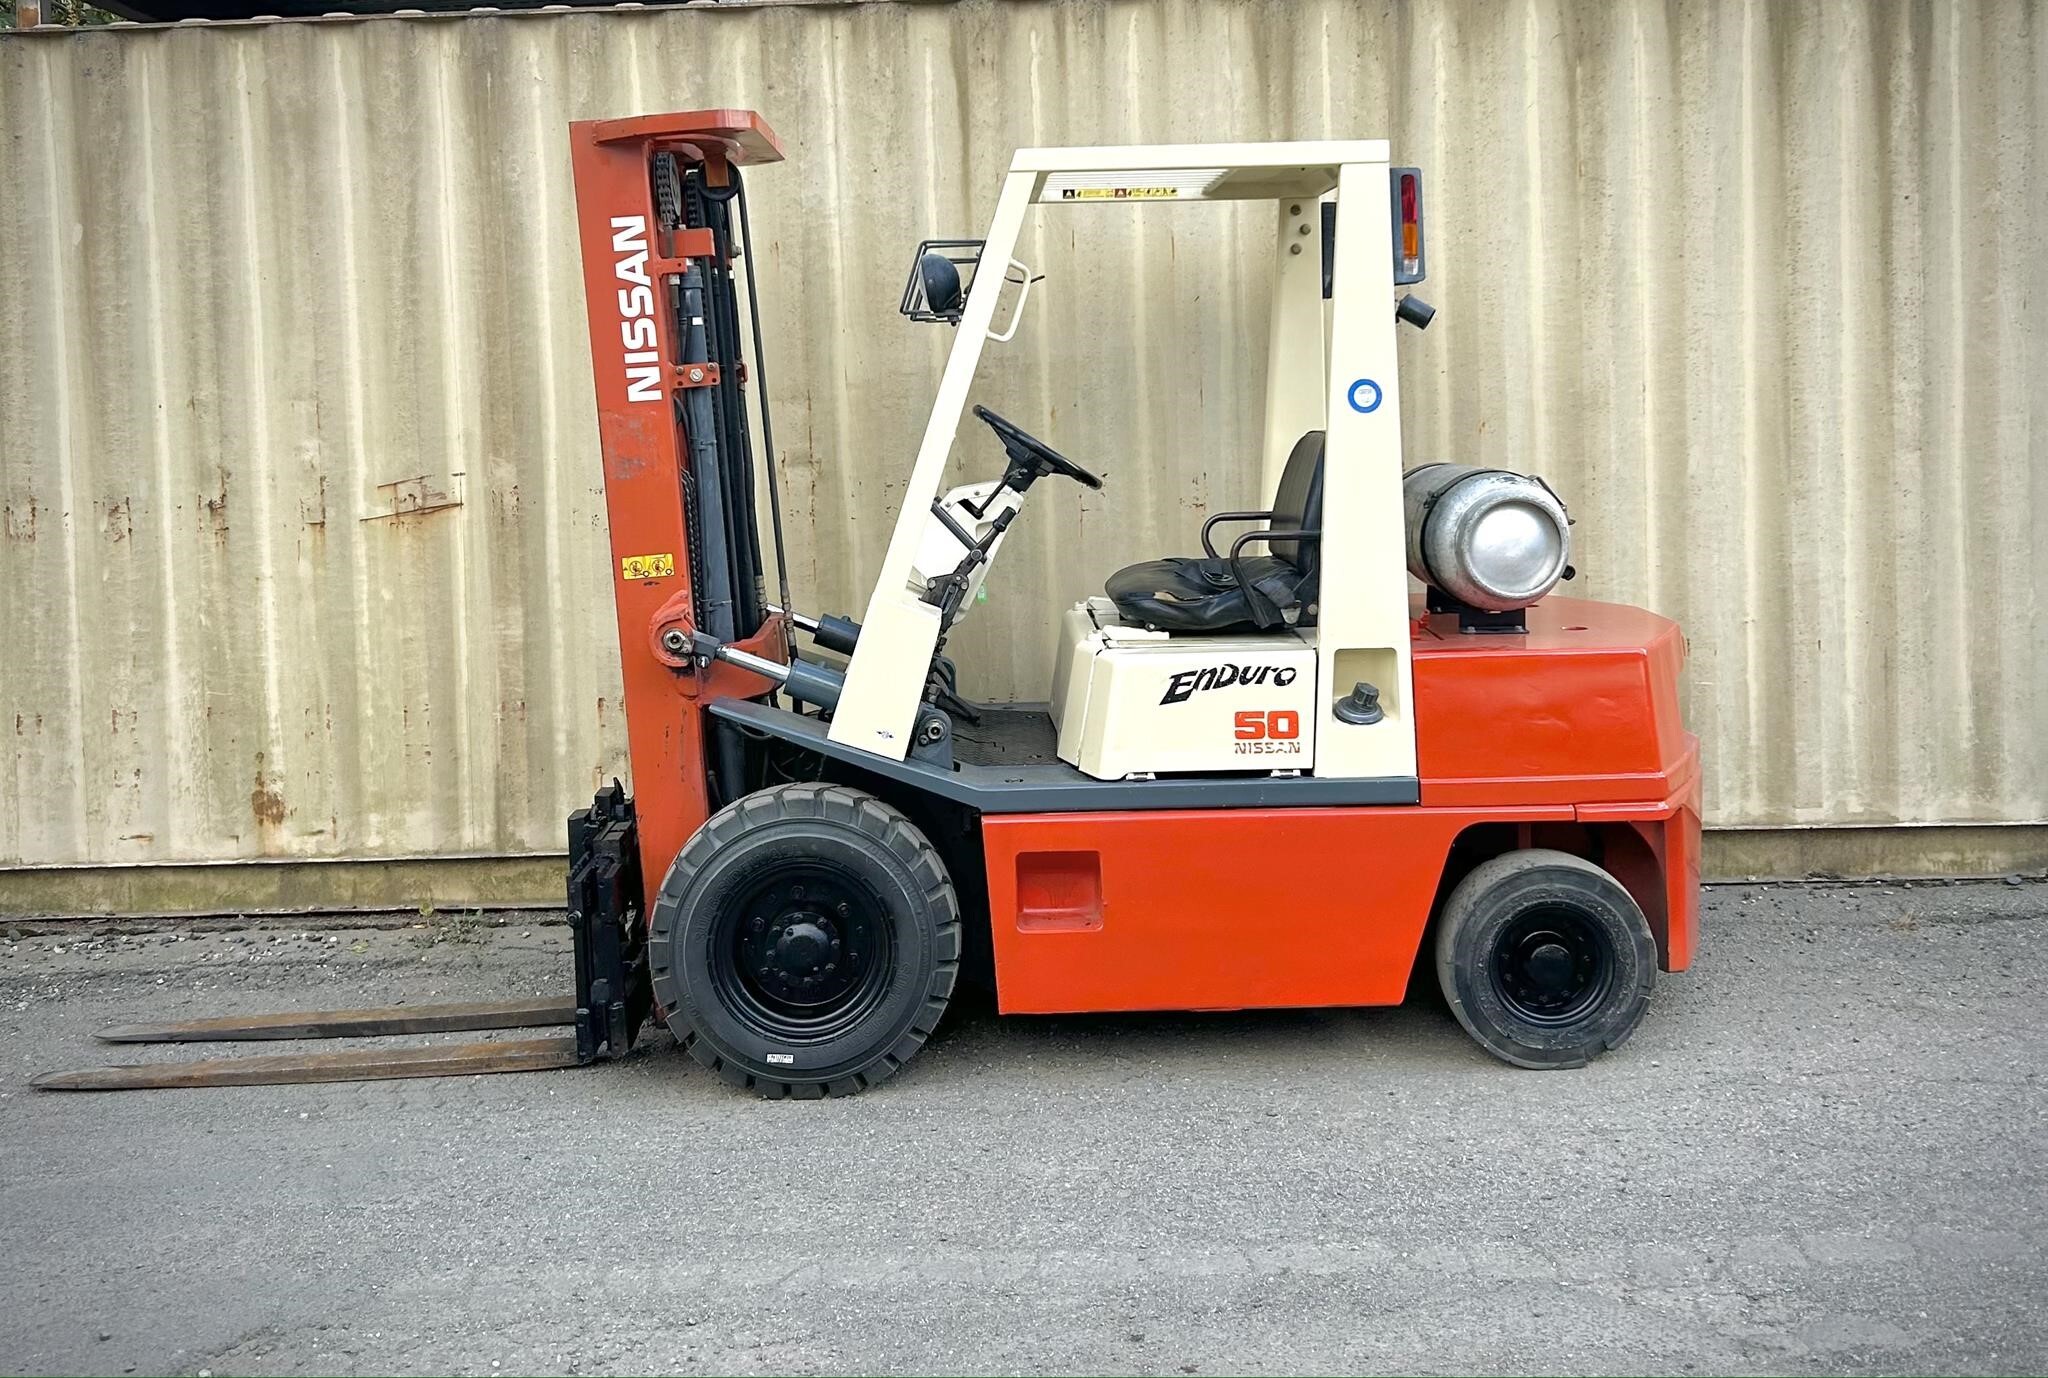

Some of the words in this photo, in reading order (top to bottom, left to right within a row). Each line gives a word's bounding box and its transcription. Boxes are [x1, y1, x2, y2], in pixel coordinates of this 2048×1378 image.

[610, 215, 662, 402] NISSAN
[1234, 710, 1299, 740] 50
[1234, 741, 1301, 754] NISSAN
